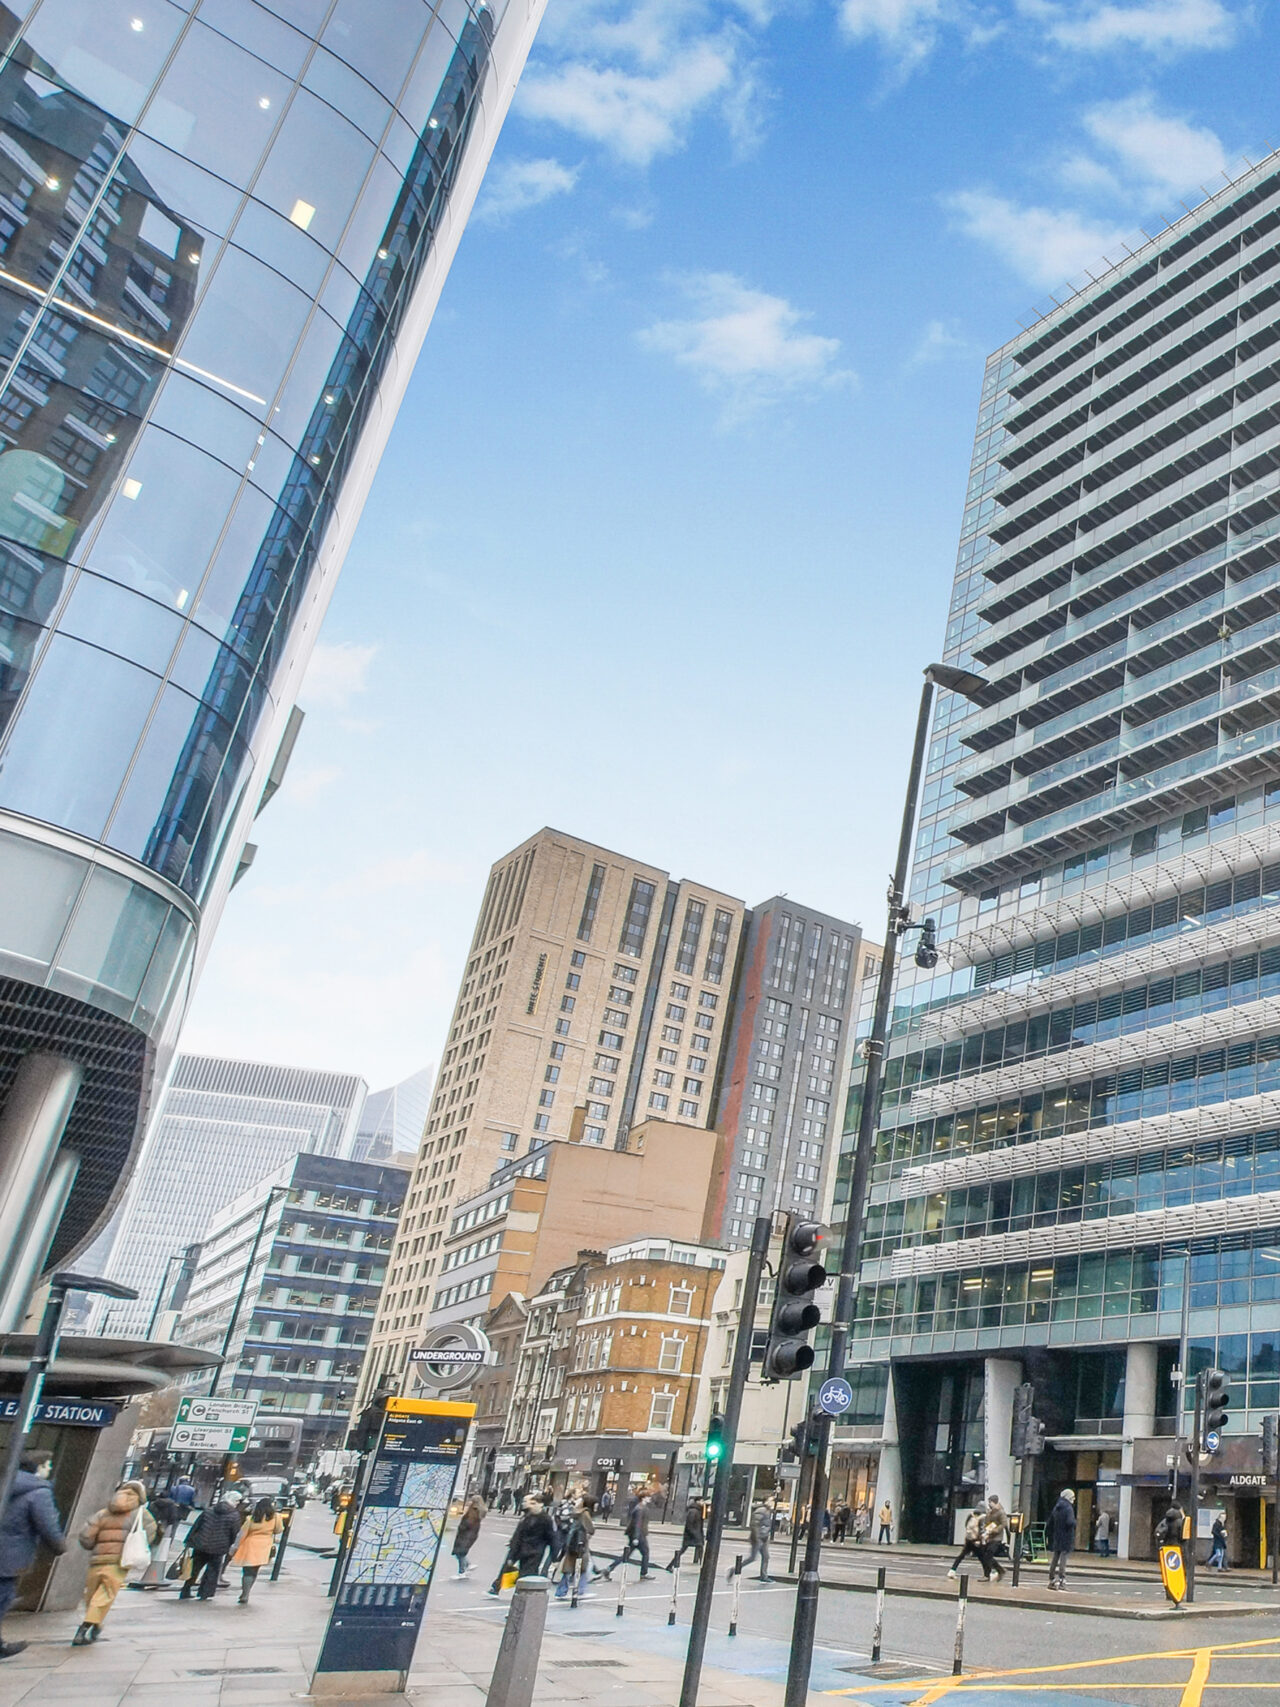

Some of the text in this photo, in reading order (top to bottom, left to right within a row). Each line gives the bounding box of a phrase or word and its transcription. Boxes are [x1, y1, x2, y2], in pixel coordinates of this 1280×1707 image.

[412, 1351, 482, 1361] UNDERGROUND
[4, 1402, 103, 1421] ET STATION
[1229, 1475, 1267, 1485] ALDGATE
